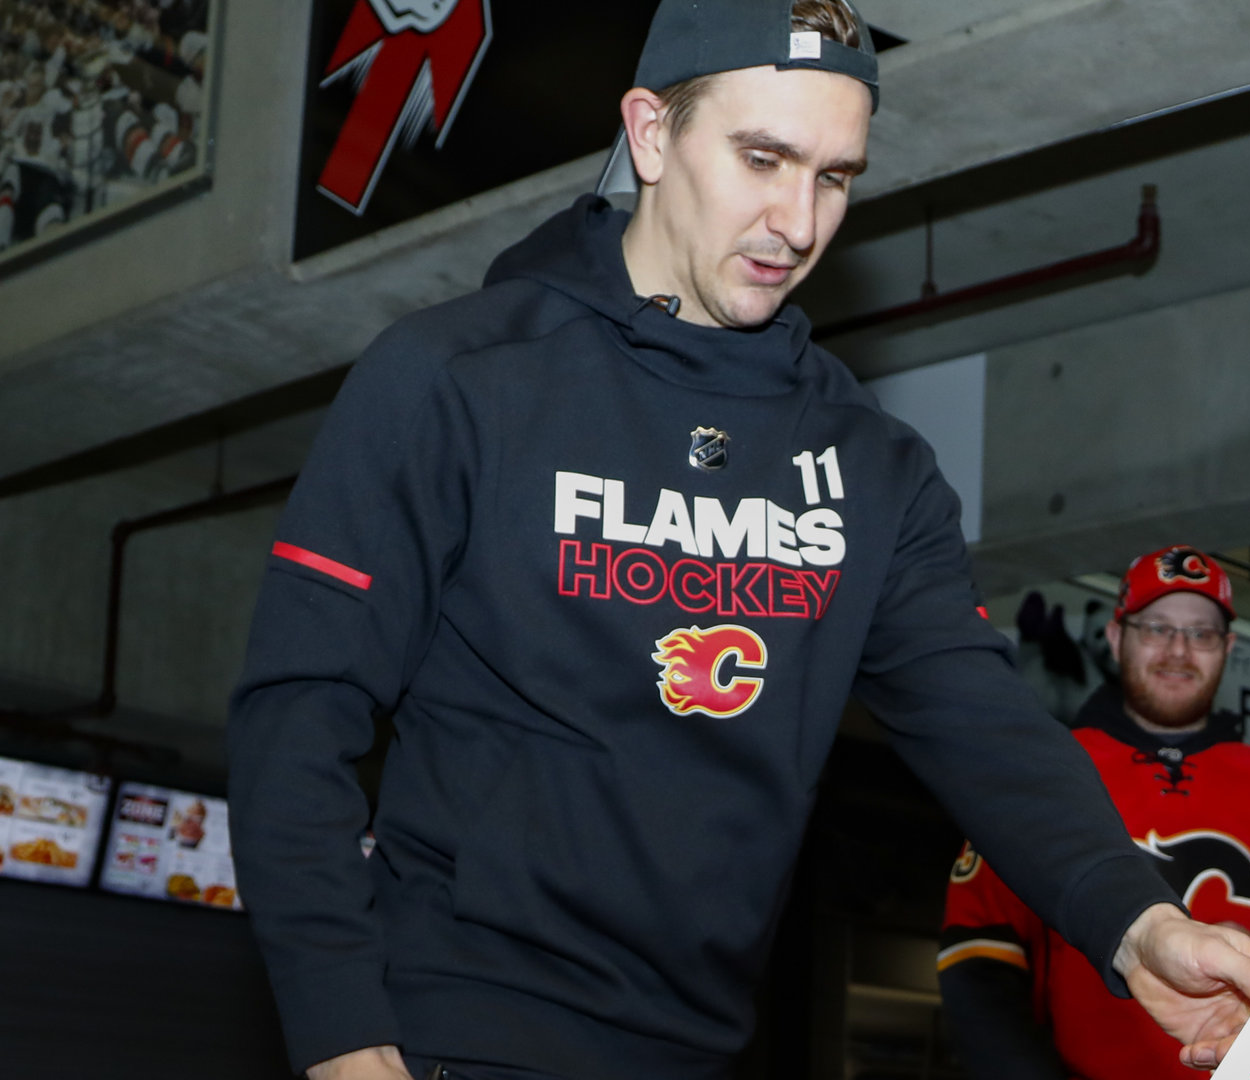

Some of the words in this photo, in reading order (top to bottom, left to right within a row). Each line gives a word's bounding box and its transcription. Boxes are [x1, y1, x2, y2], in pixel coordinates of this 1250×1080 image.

[792, 446, 845, 505] 11
[554, 471, 846, 567] FLAMES
[558, 539, 841, 620] HOCKEY
